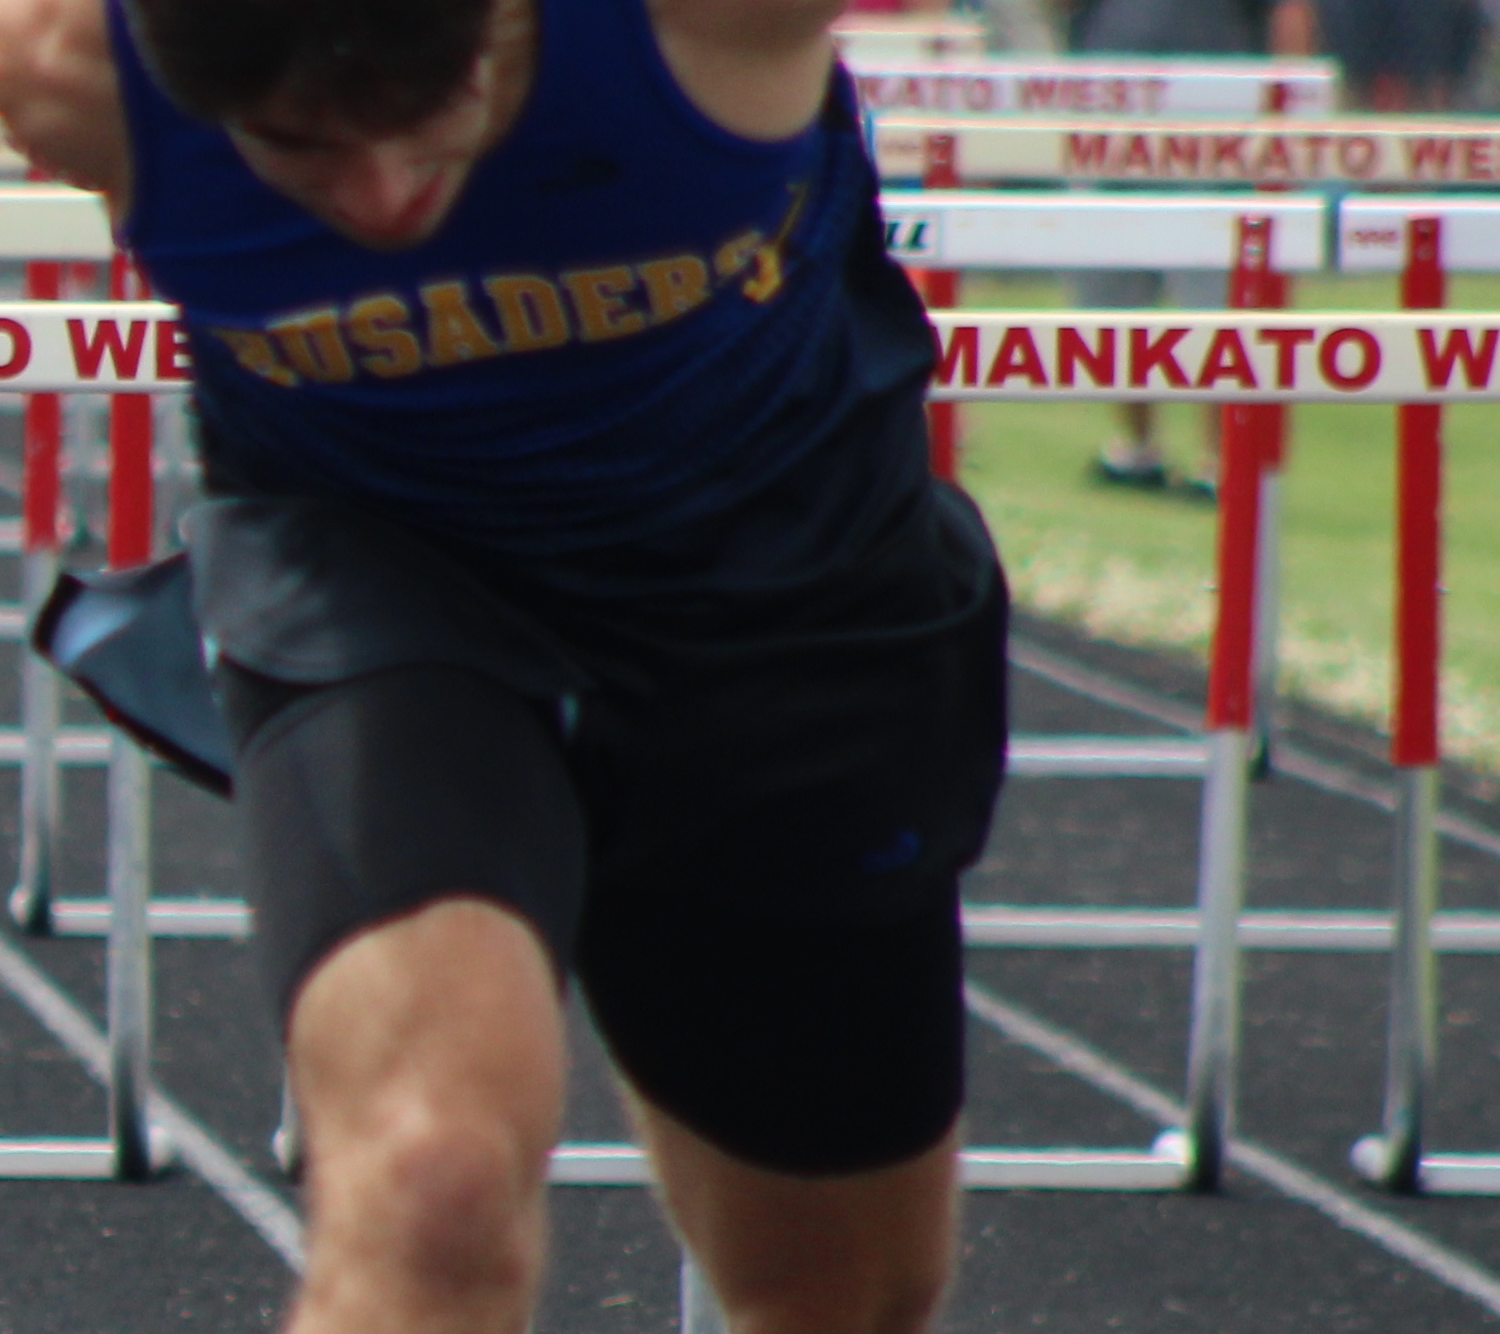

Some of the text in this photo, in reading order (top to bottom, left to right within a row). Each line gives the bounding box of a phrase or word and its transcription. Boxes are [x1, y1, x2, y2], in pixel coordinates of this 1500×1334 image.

[1021, 79, 1167, 113] WEST
[1063, 133, 1379, 178] MANKATO
[934, 325, 1384, 391] MANKATO
